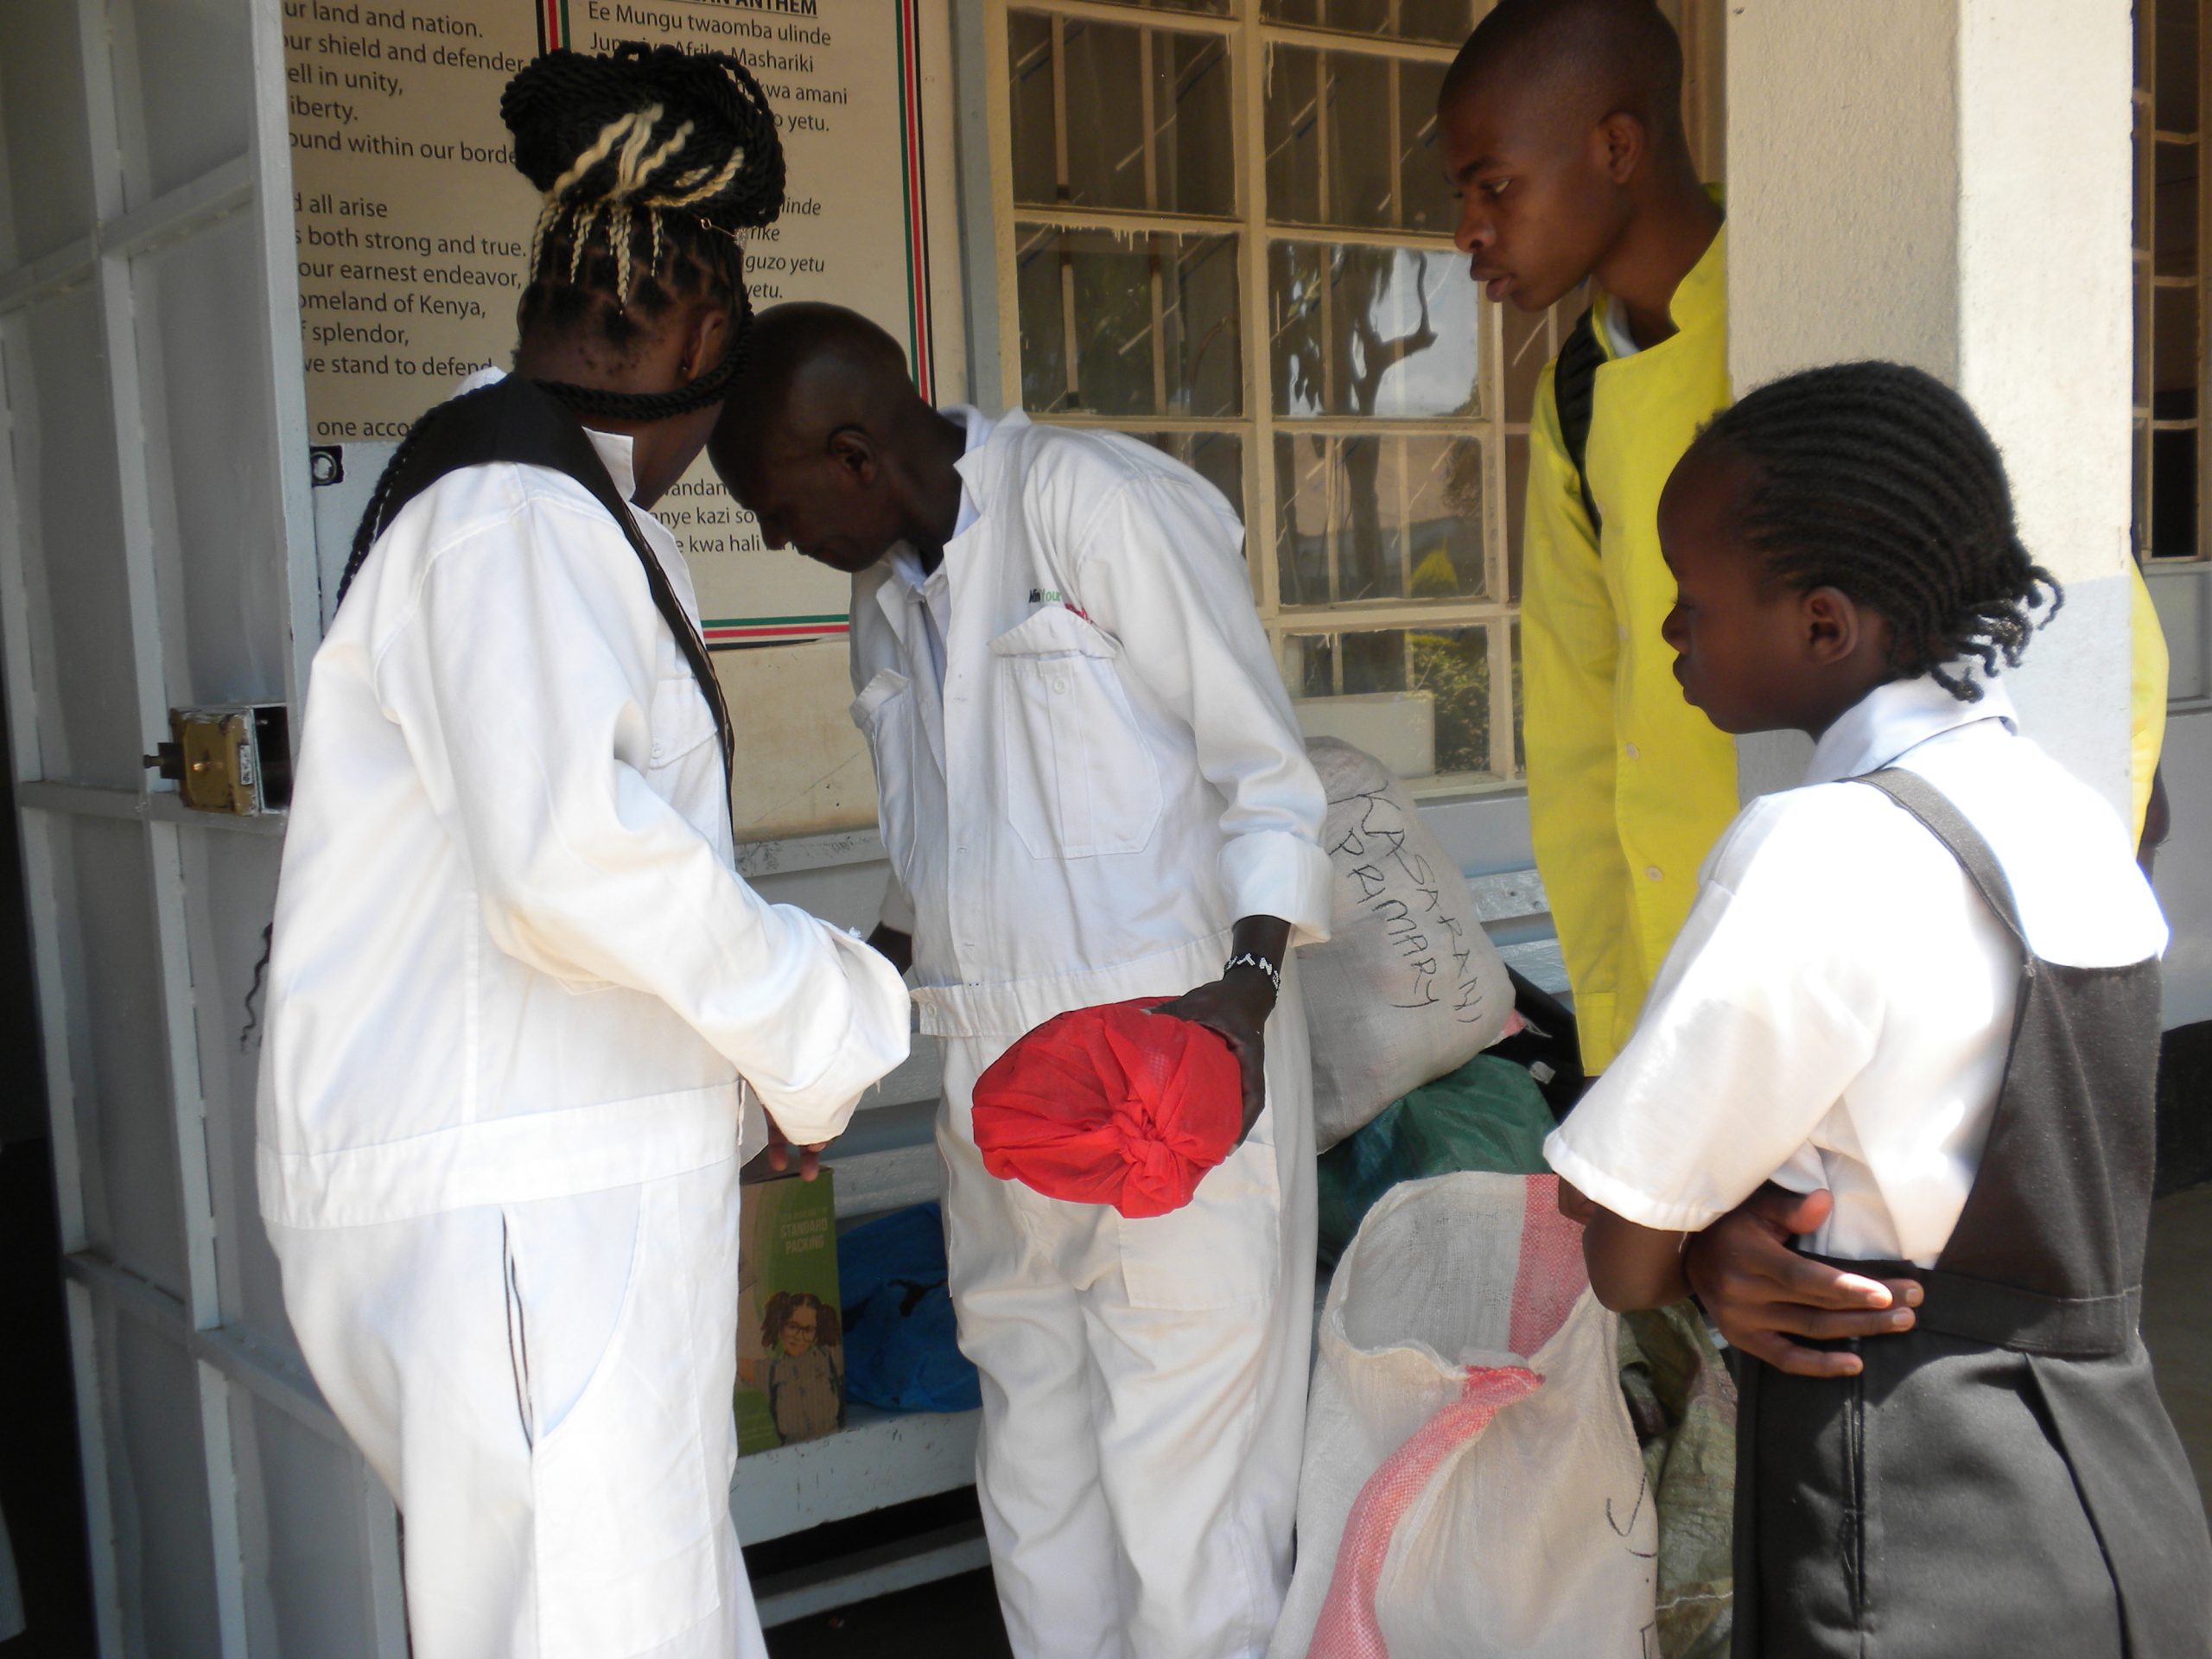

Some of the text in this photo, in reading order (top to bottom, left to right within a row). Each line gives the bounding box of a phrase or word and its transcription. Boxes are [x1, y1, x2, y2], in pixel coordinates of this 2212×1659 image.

[285, 0, 483, 37] ur land and nation.
[588, 1, 610, 21] Ee
[616, 4, 682, 32] Mungu
[688, 15, 772, 40] twaomba
[779, 23, 831, 46] ulinde
[319, 34, 381, 59] shield
[387, 43, 427, 63] and
[732, 46, 814, 73] Mashariki
[288, 64, 404, 96] ell in unity,
[290, 96, 359, 124] iberty.
[796, 89, 848, 105] amani
[788, 116, 830, 133] yetu.
[289, 130, 516, 164] ound within our borde
[309, 194, 333, 214] all
[340, 196, 388, 217] arise
[781, 198, 821, 215] linde
[308, 226, 358, 248] both
[365, 232, 431, 256] strong
[438, 235, 475, 255] and
[481, 238, 526, 257] true.
[299, 263, 522, 289] our earnest endeavor,
[746, 255, 824, 275] guzo yetu
[301, 291, 486, 321] omeland of Kenya,
[312, 324, 409, 346] splendor,
[332, 353, 389, 374] stand
[395, 359, 416, 375] to
[317, 422, 410, 437] one acco
[697, 507, 730, 524] kazi
[735, 511, 754, 523] so
[690, 535, 724, 553] kwa
[729, 534, 760, 552] hali
[1328, 827, 1440, 1008] PRIMARY
